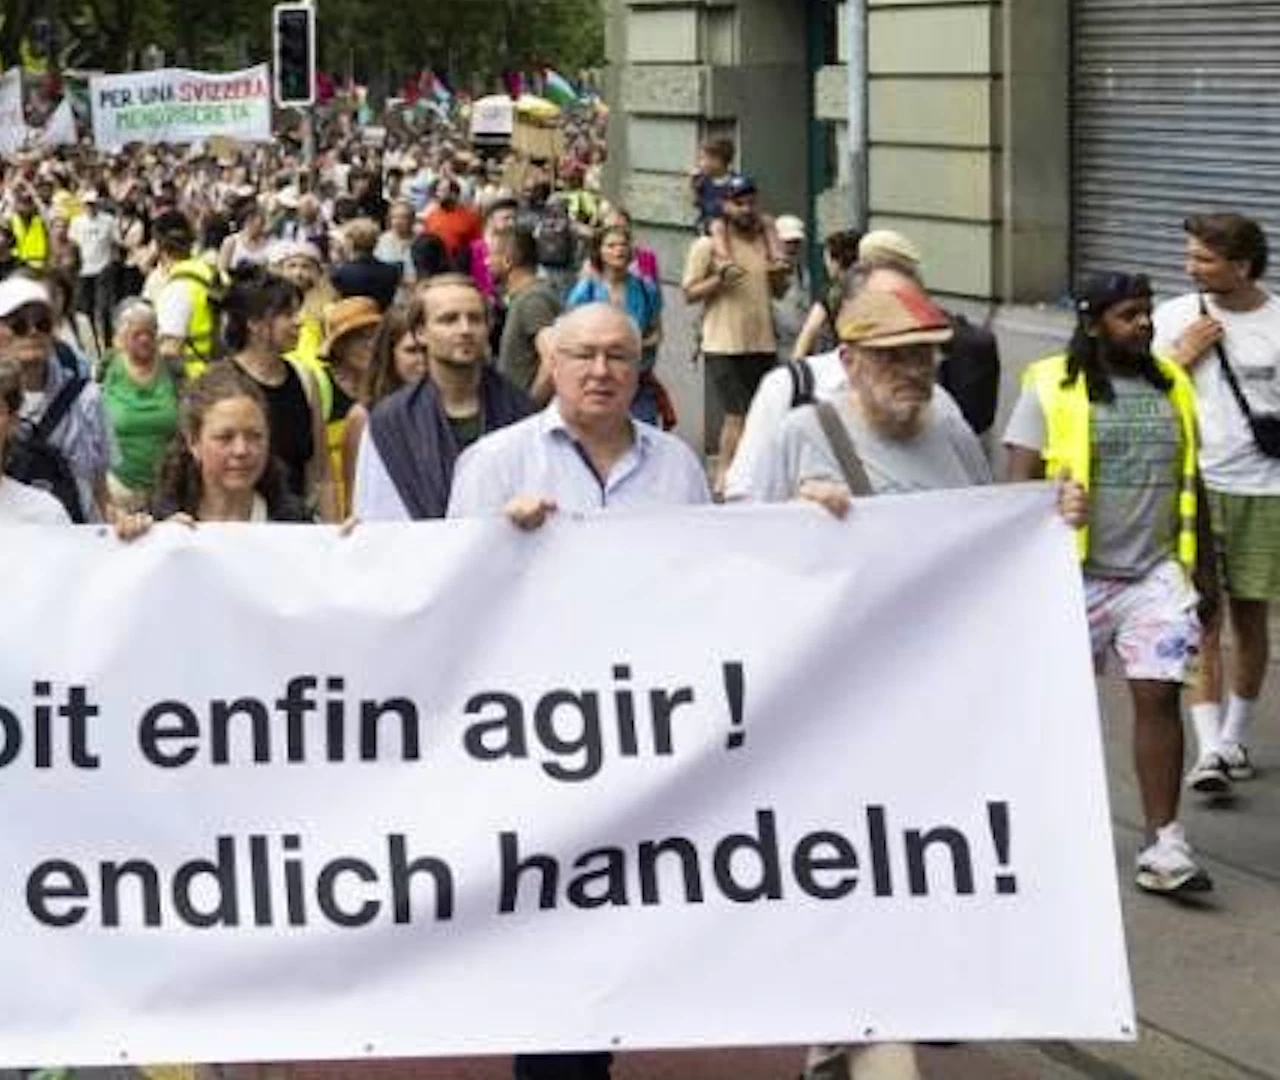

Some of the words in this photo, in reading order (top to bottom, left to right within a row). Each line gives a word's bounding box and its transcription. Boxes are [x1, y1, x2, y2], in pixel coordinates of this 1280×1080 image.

[99, 89, 132, 109] PER
[139, 675, 420, 768] enfin
[26, 834, 454, 929] endlich
[498, 801, 1018, 915] handeln!
